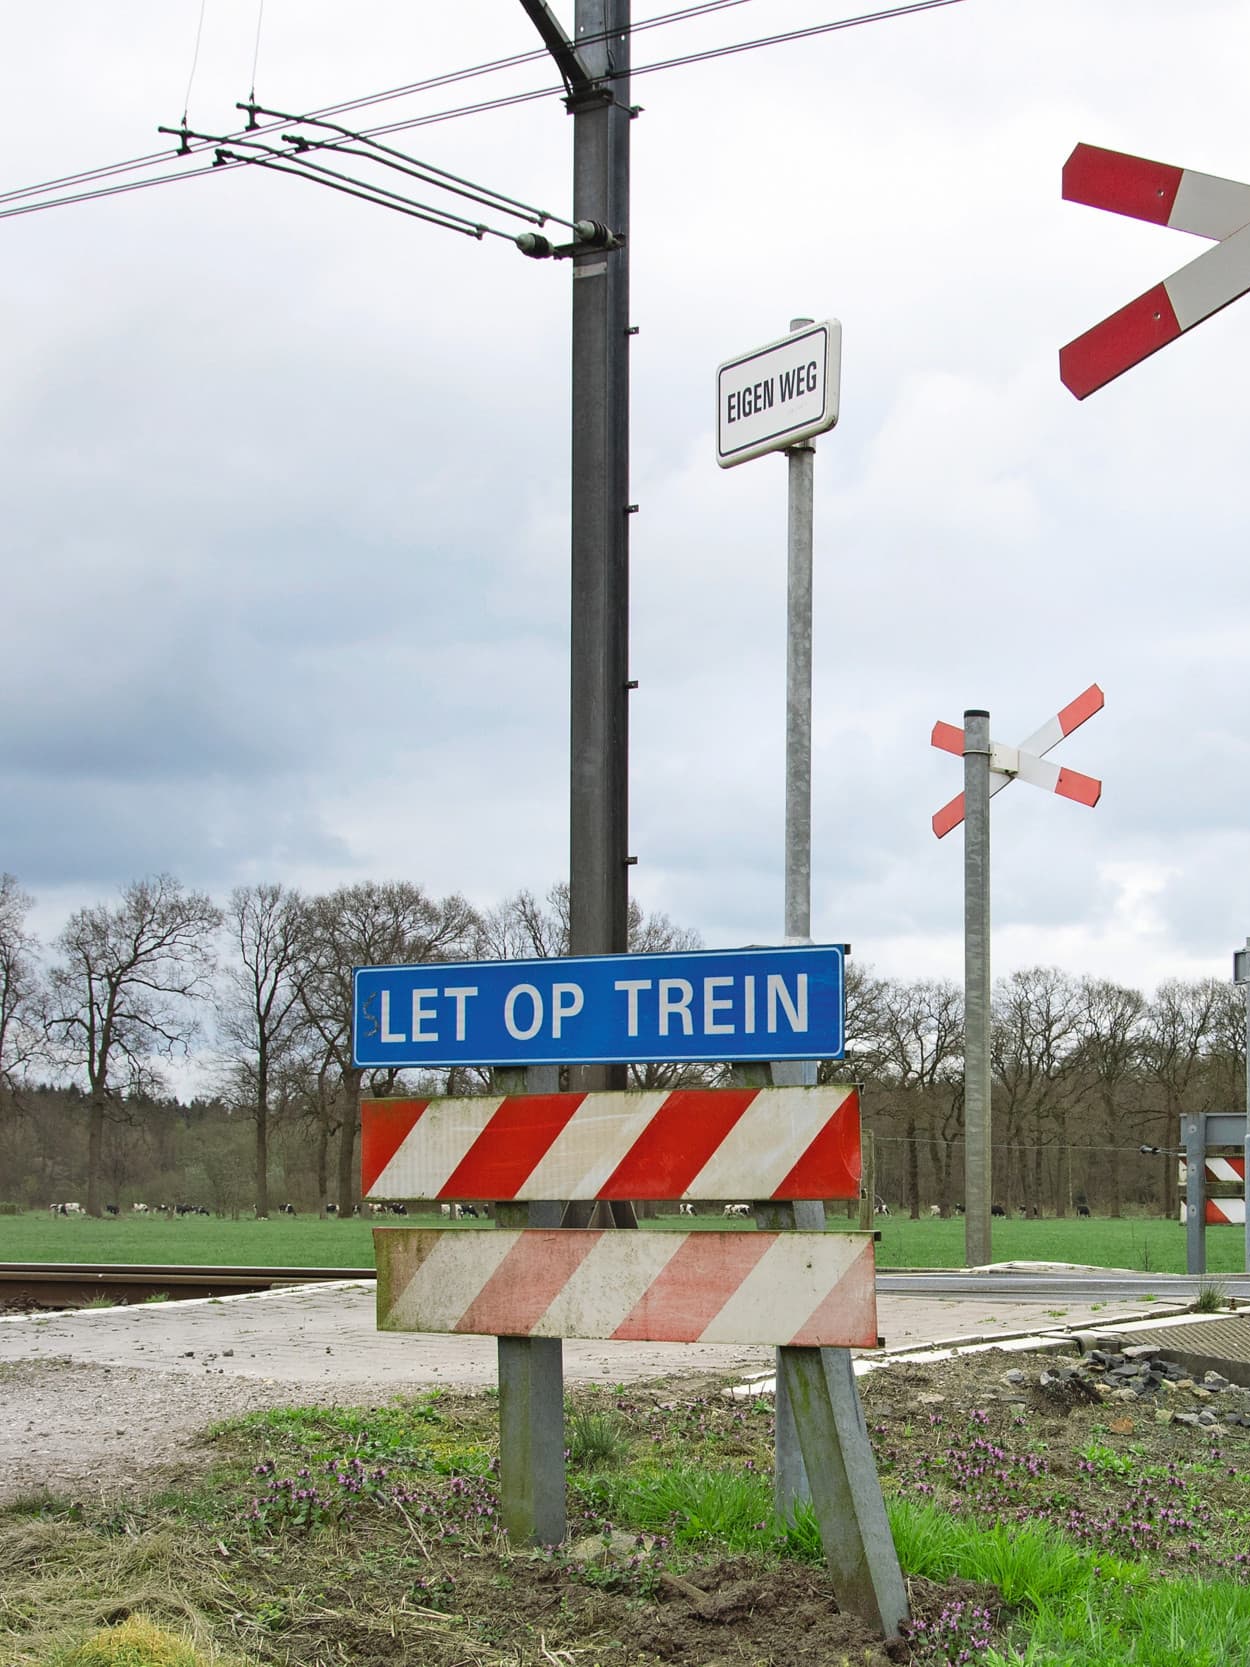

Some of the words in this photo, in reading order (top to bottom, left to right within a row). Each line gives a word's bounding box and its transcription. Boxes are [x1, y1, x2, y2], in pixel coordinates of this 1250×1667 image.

[727, 377, 774, 423] EIGEN
[779, 361, 817, 403] WEG
[381, 987, 479, 1043] LET
[504, 982, 584, 1041] OP
[614, 973, 809, 1038] TREIN
